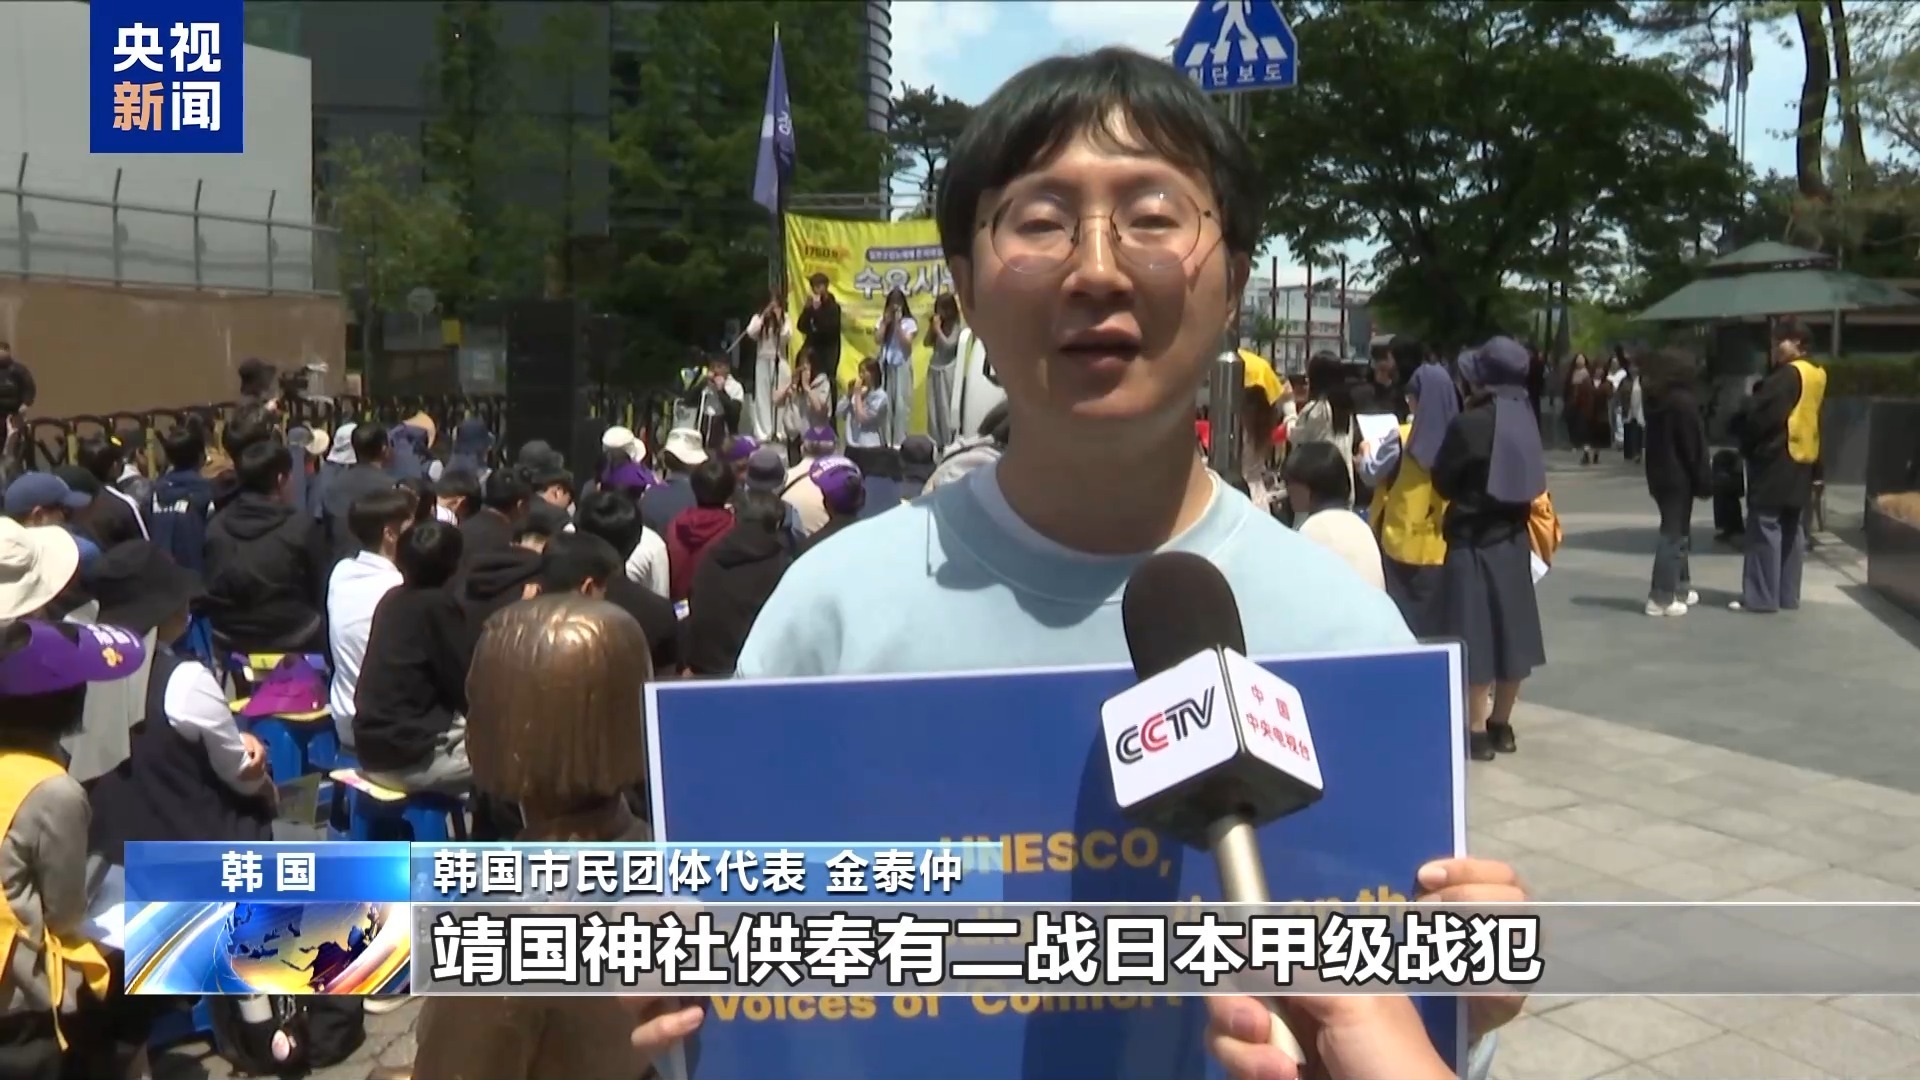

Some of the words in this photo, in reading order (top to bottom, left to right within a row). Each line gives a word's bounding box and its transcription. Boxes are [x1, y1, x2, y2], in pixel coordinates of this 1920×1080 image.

[1115, 685, 1216, 765] CCTV
[1250, 683, 1291, 722] 中国
[1246, 712, 1311, 762] 中央电视台
